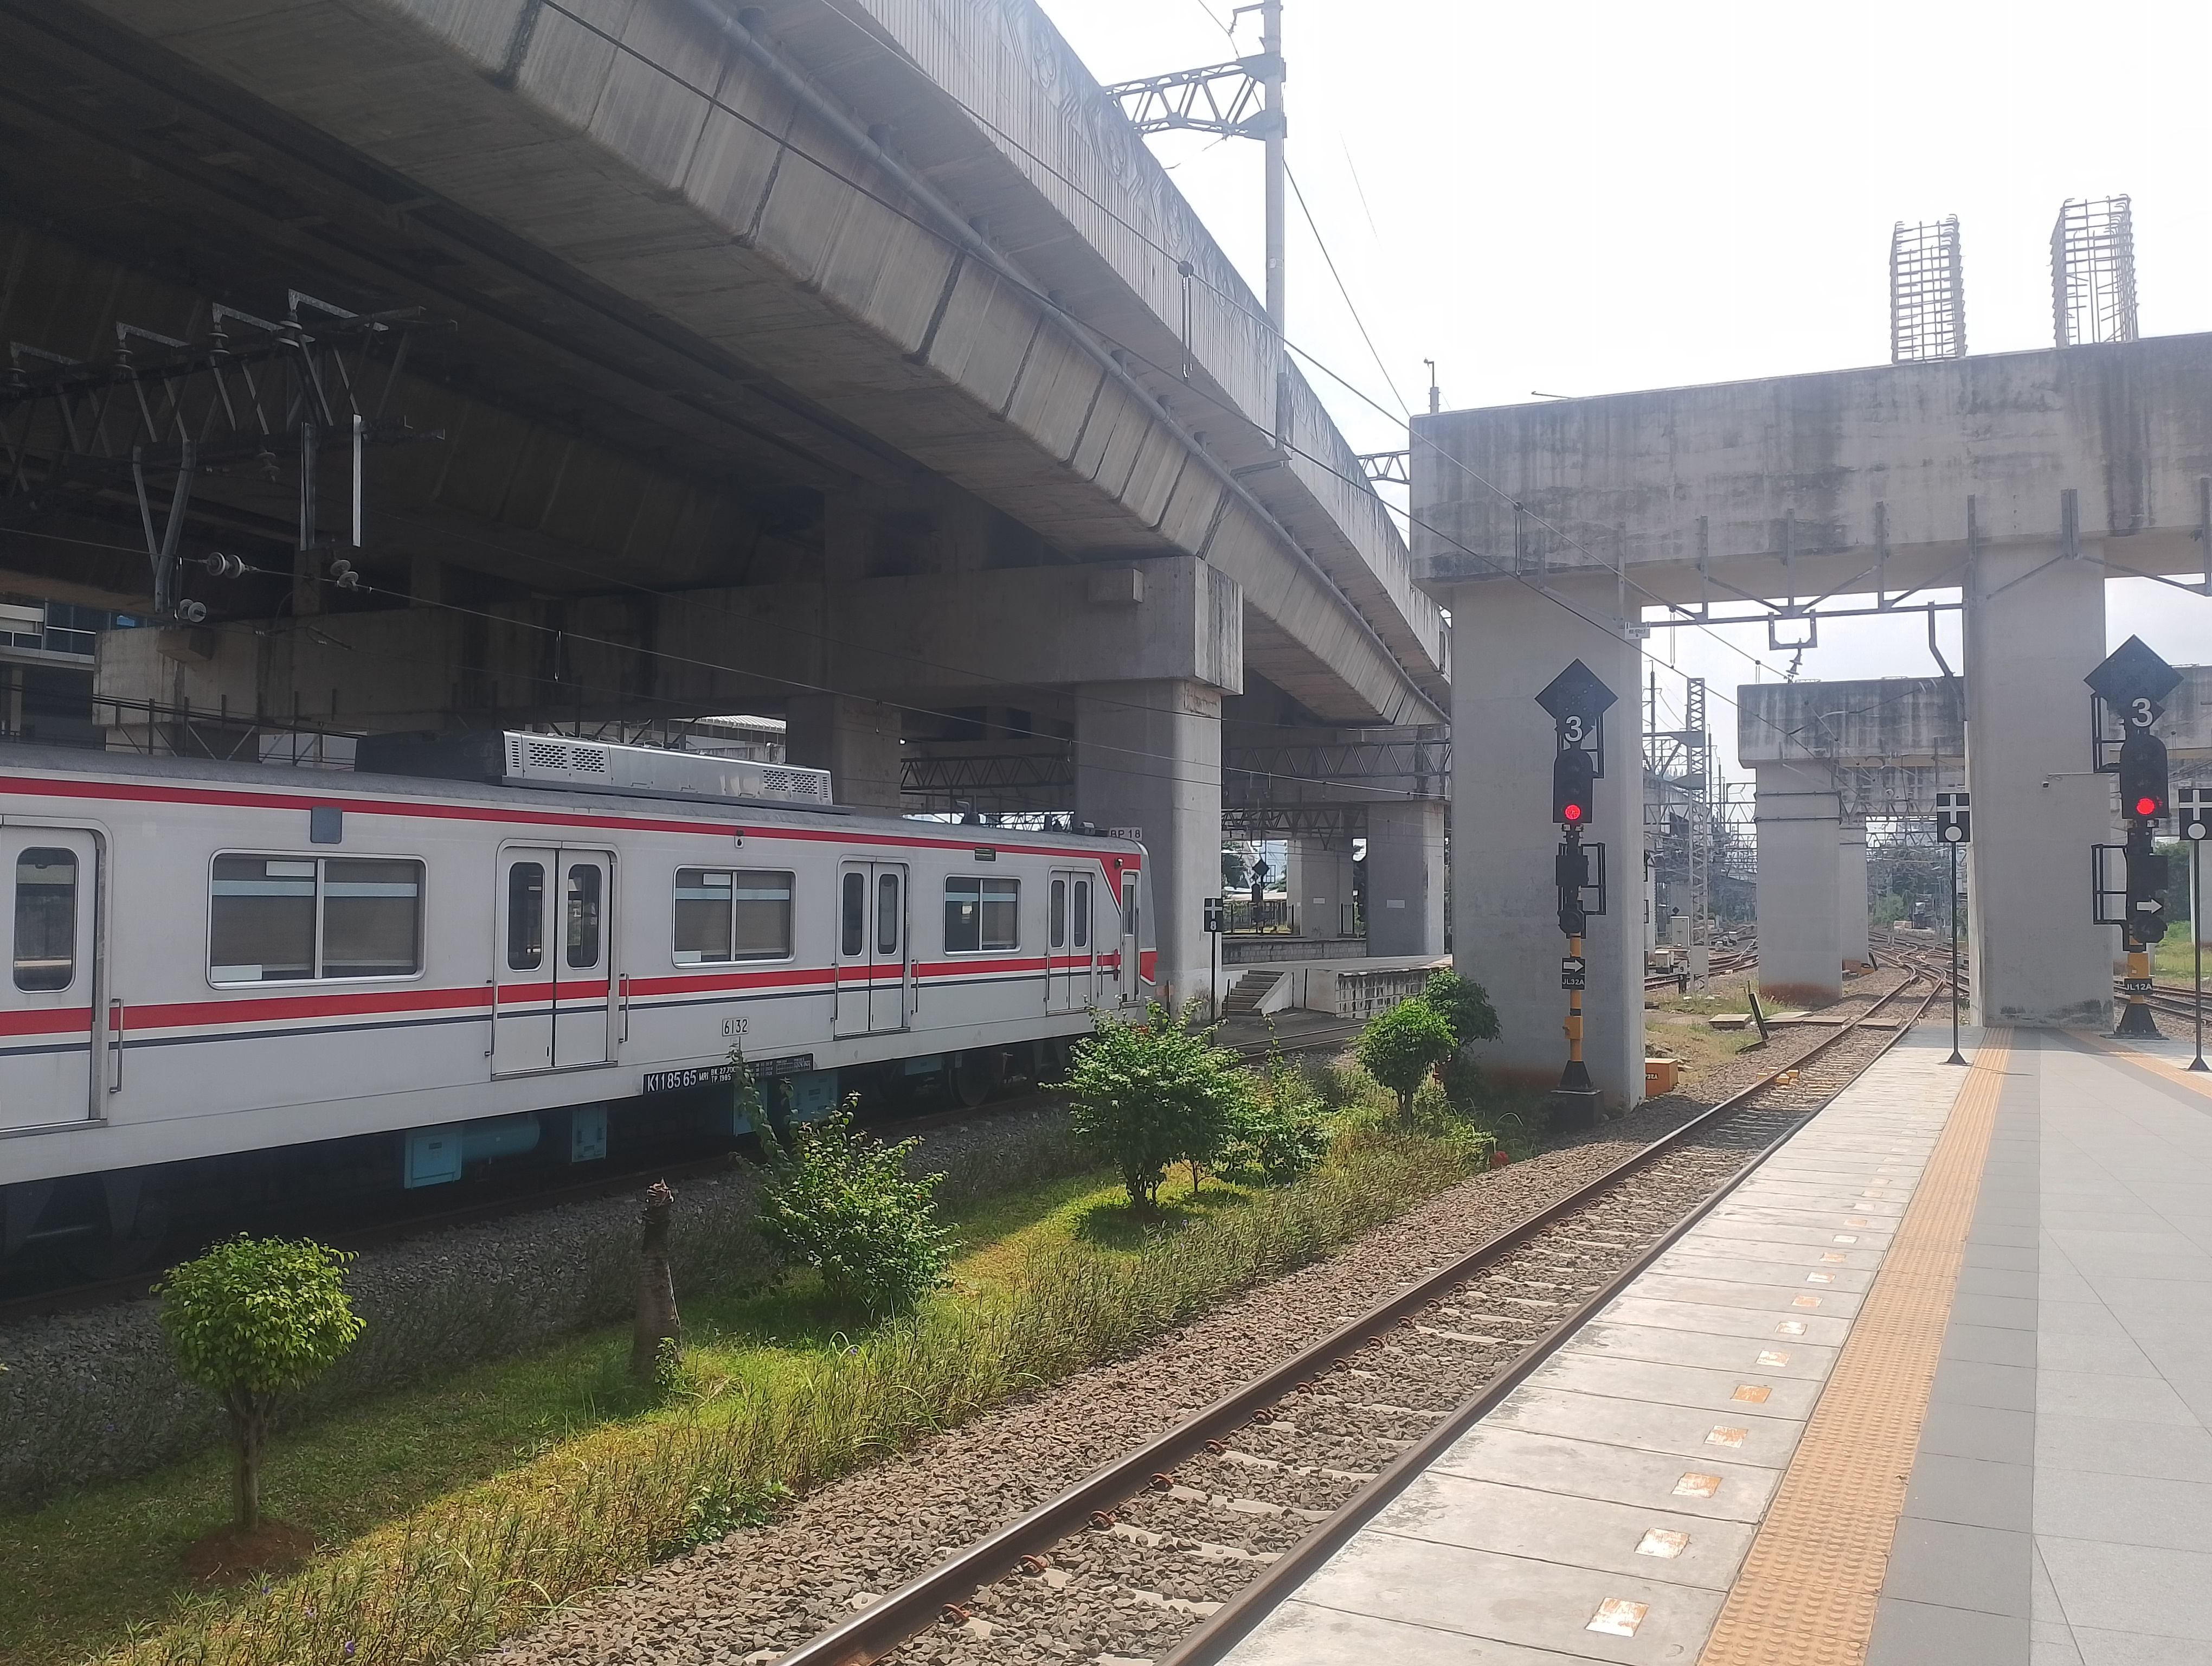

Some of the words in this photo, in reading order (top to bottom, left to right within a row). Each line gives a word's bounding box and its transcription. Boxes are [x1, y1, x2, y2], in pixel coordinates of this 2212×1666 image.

[2132, 698, 2153, 727] 3
[1565, 716, 1583, 741] 3
[1110, 830, 1124, 838] BP
[1128, 829, 1141, 838] 18
[1210, 921, 1217, 930] 8
[724, 1019, 748, 1034] 6132
[699, 1071, 709, 1081] MRI
[711, 1075, 718, 1084] TP
